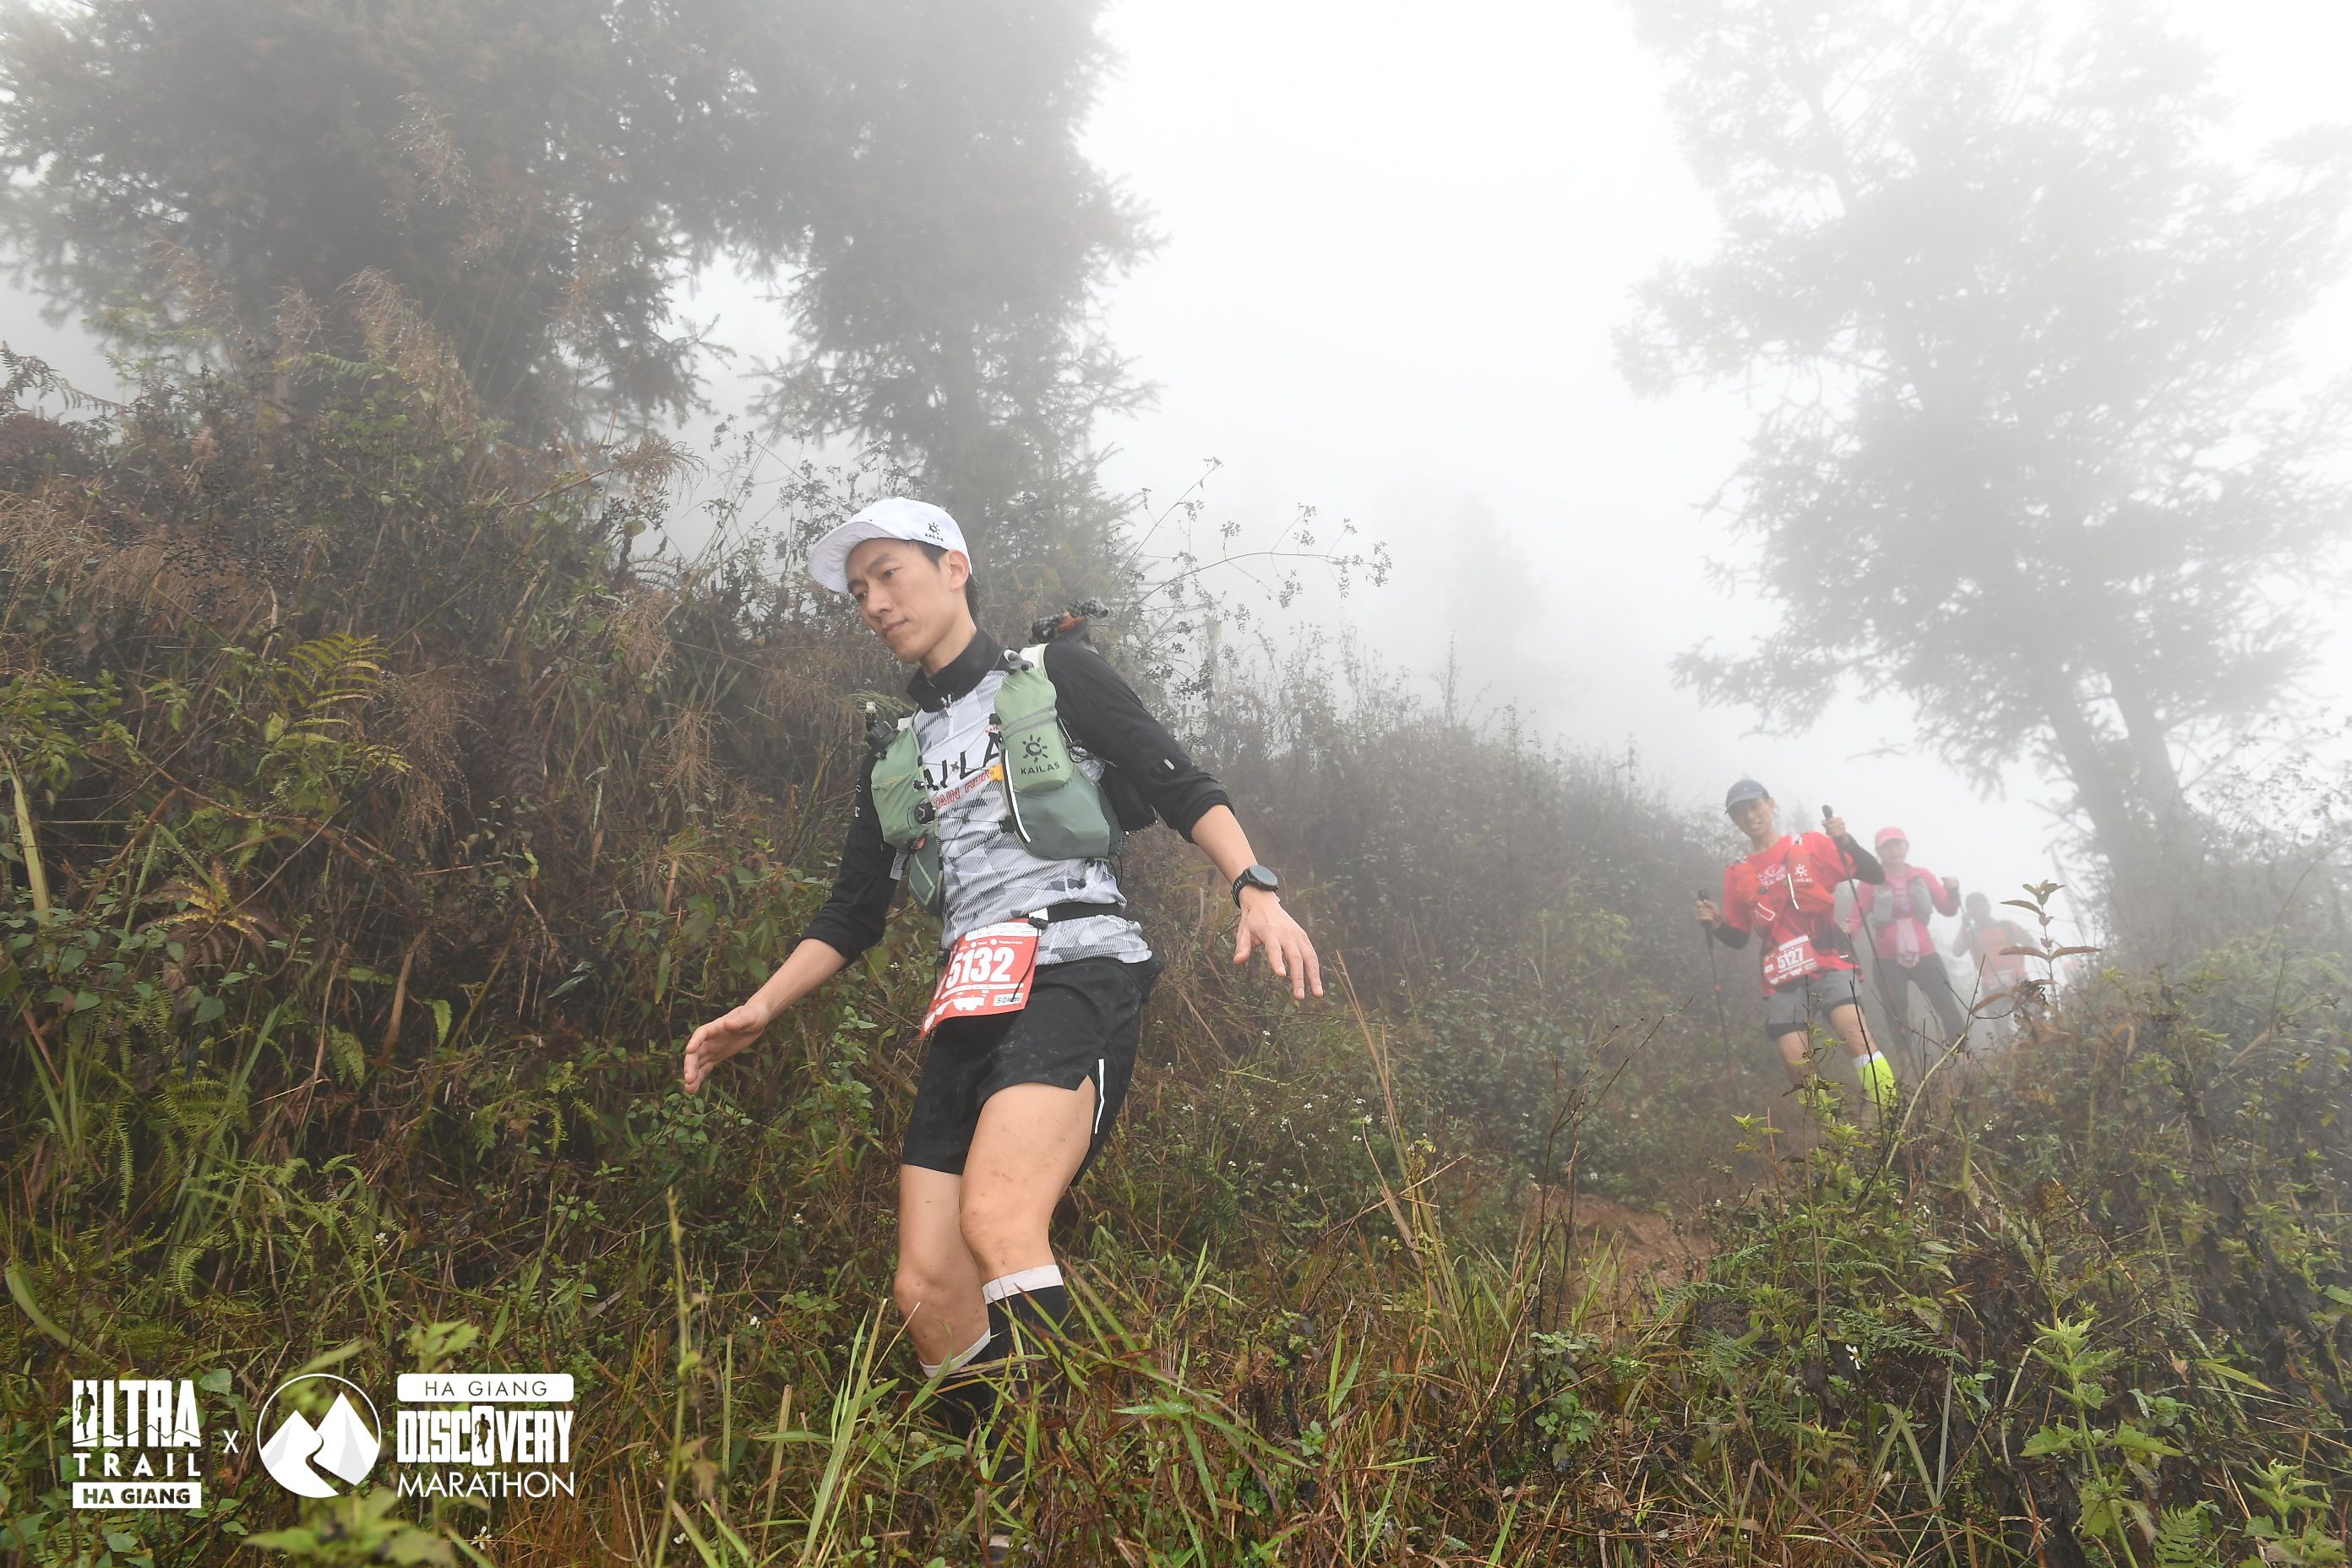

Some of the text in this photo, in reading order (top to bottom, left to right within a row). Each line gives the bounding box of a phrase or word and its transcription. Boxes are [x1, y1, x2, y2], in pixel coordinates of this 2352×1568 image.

[923, 732, 1000, 792] AILA
[1020, 762, 1060, 776] KAILAS
[932, 787, 961, 811] TAIN
[945, 946, 1015, 989] 5132
[1777, 947, 1804, 970] 5127
